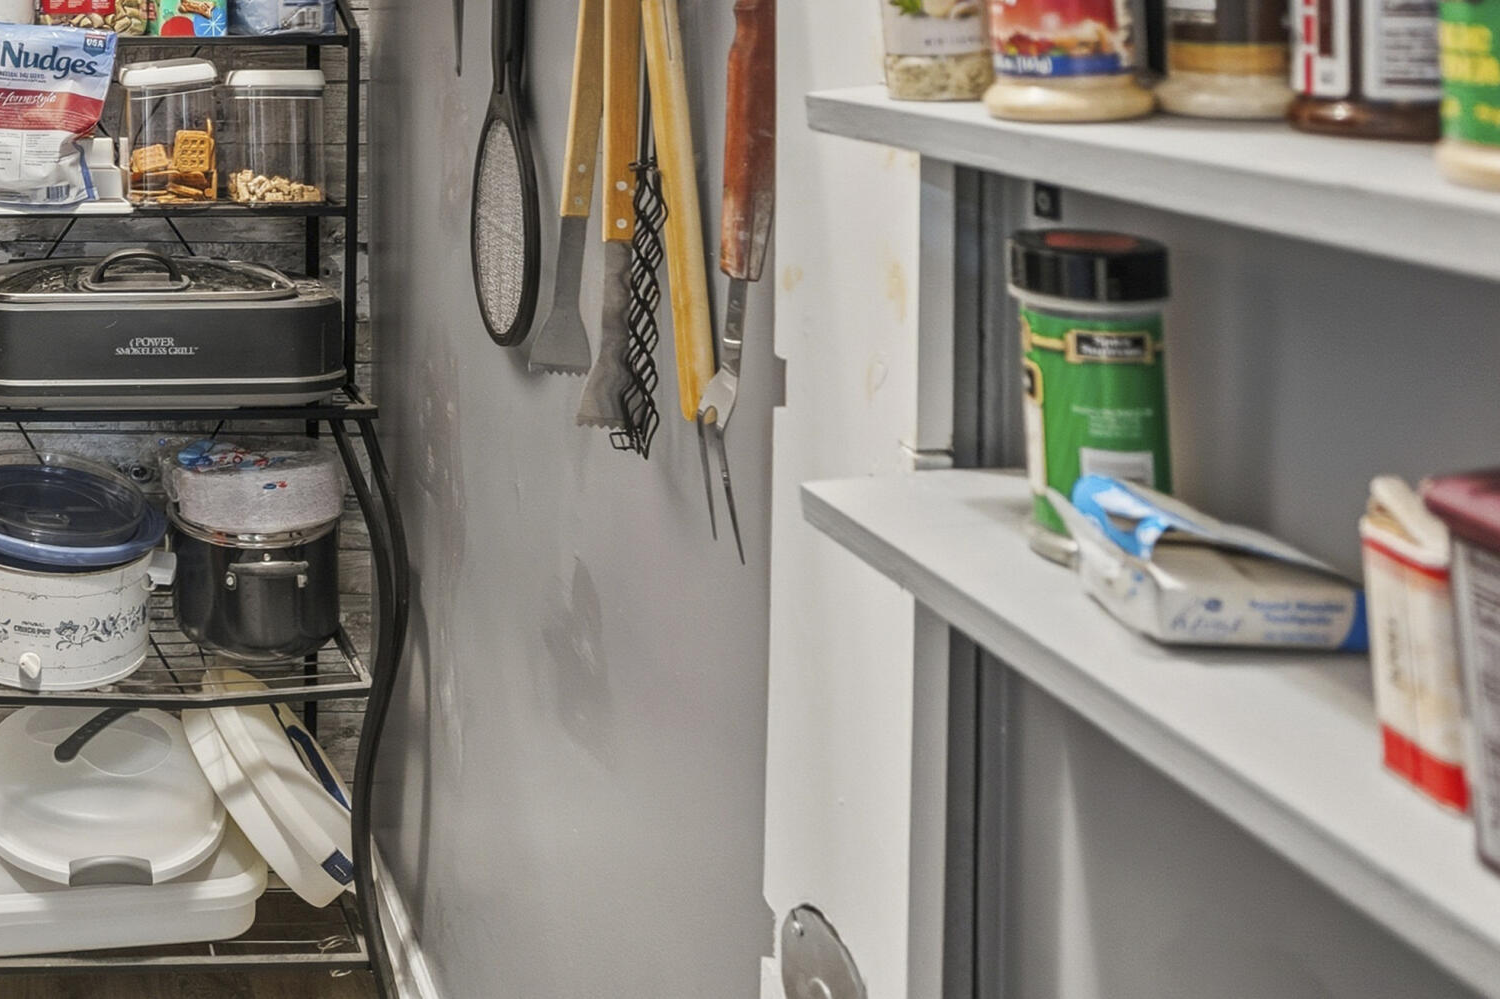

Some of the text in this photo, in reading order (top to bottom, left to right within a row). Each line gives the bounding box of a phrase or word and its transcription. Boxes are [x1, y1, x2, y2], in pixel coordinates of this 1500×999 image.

[85, 38, 105, 48] USA
[1, 39, 98, 80] Nudges
[135, 336, 175, 347] POWER
[115, 346, 195, 355] SMOKELESS GRILL
